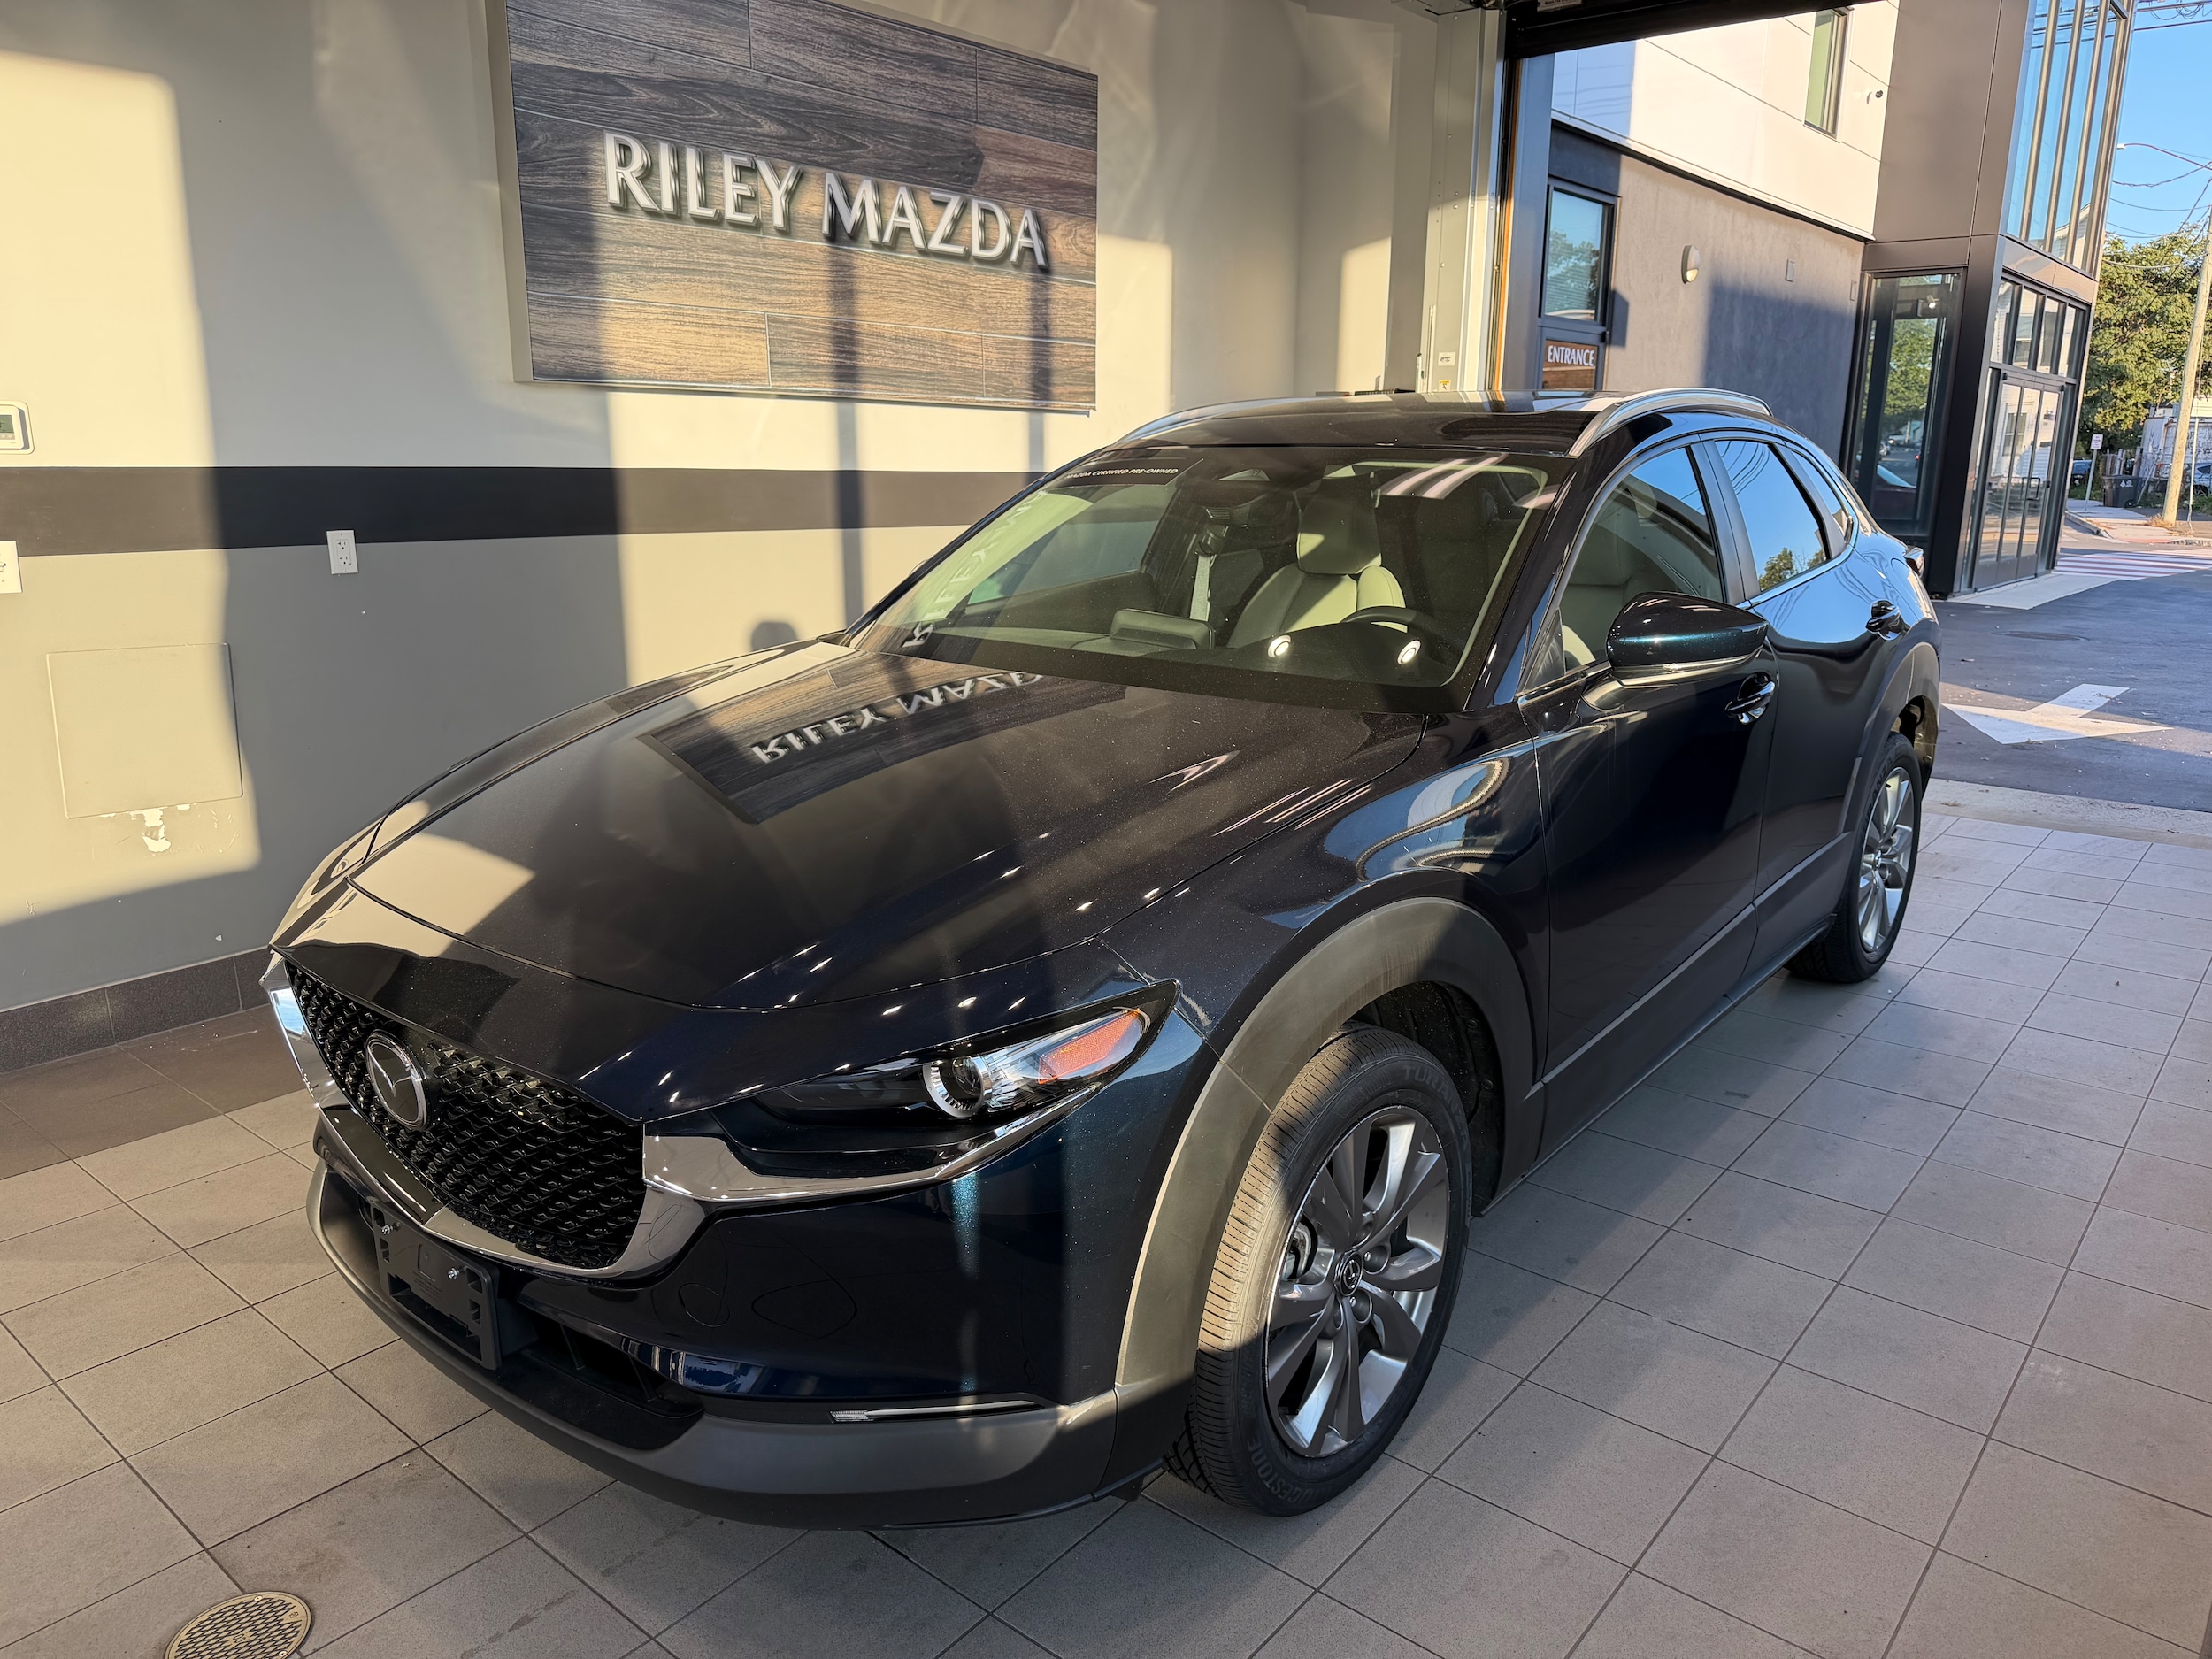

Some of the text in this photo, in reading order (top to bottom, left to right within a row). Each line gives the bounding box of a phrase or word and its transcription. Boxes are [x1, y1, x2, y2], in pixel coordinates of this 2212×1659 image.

[603, 130, 1049, 269] RILEY MAZDA
[1548, 345, 1594, 366] ENTRANCE
[1402, 1064, 1470, 1152] TURANZA
[1247, 1433, 1332, 1504] DGESTONE
